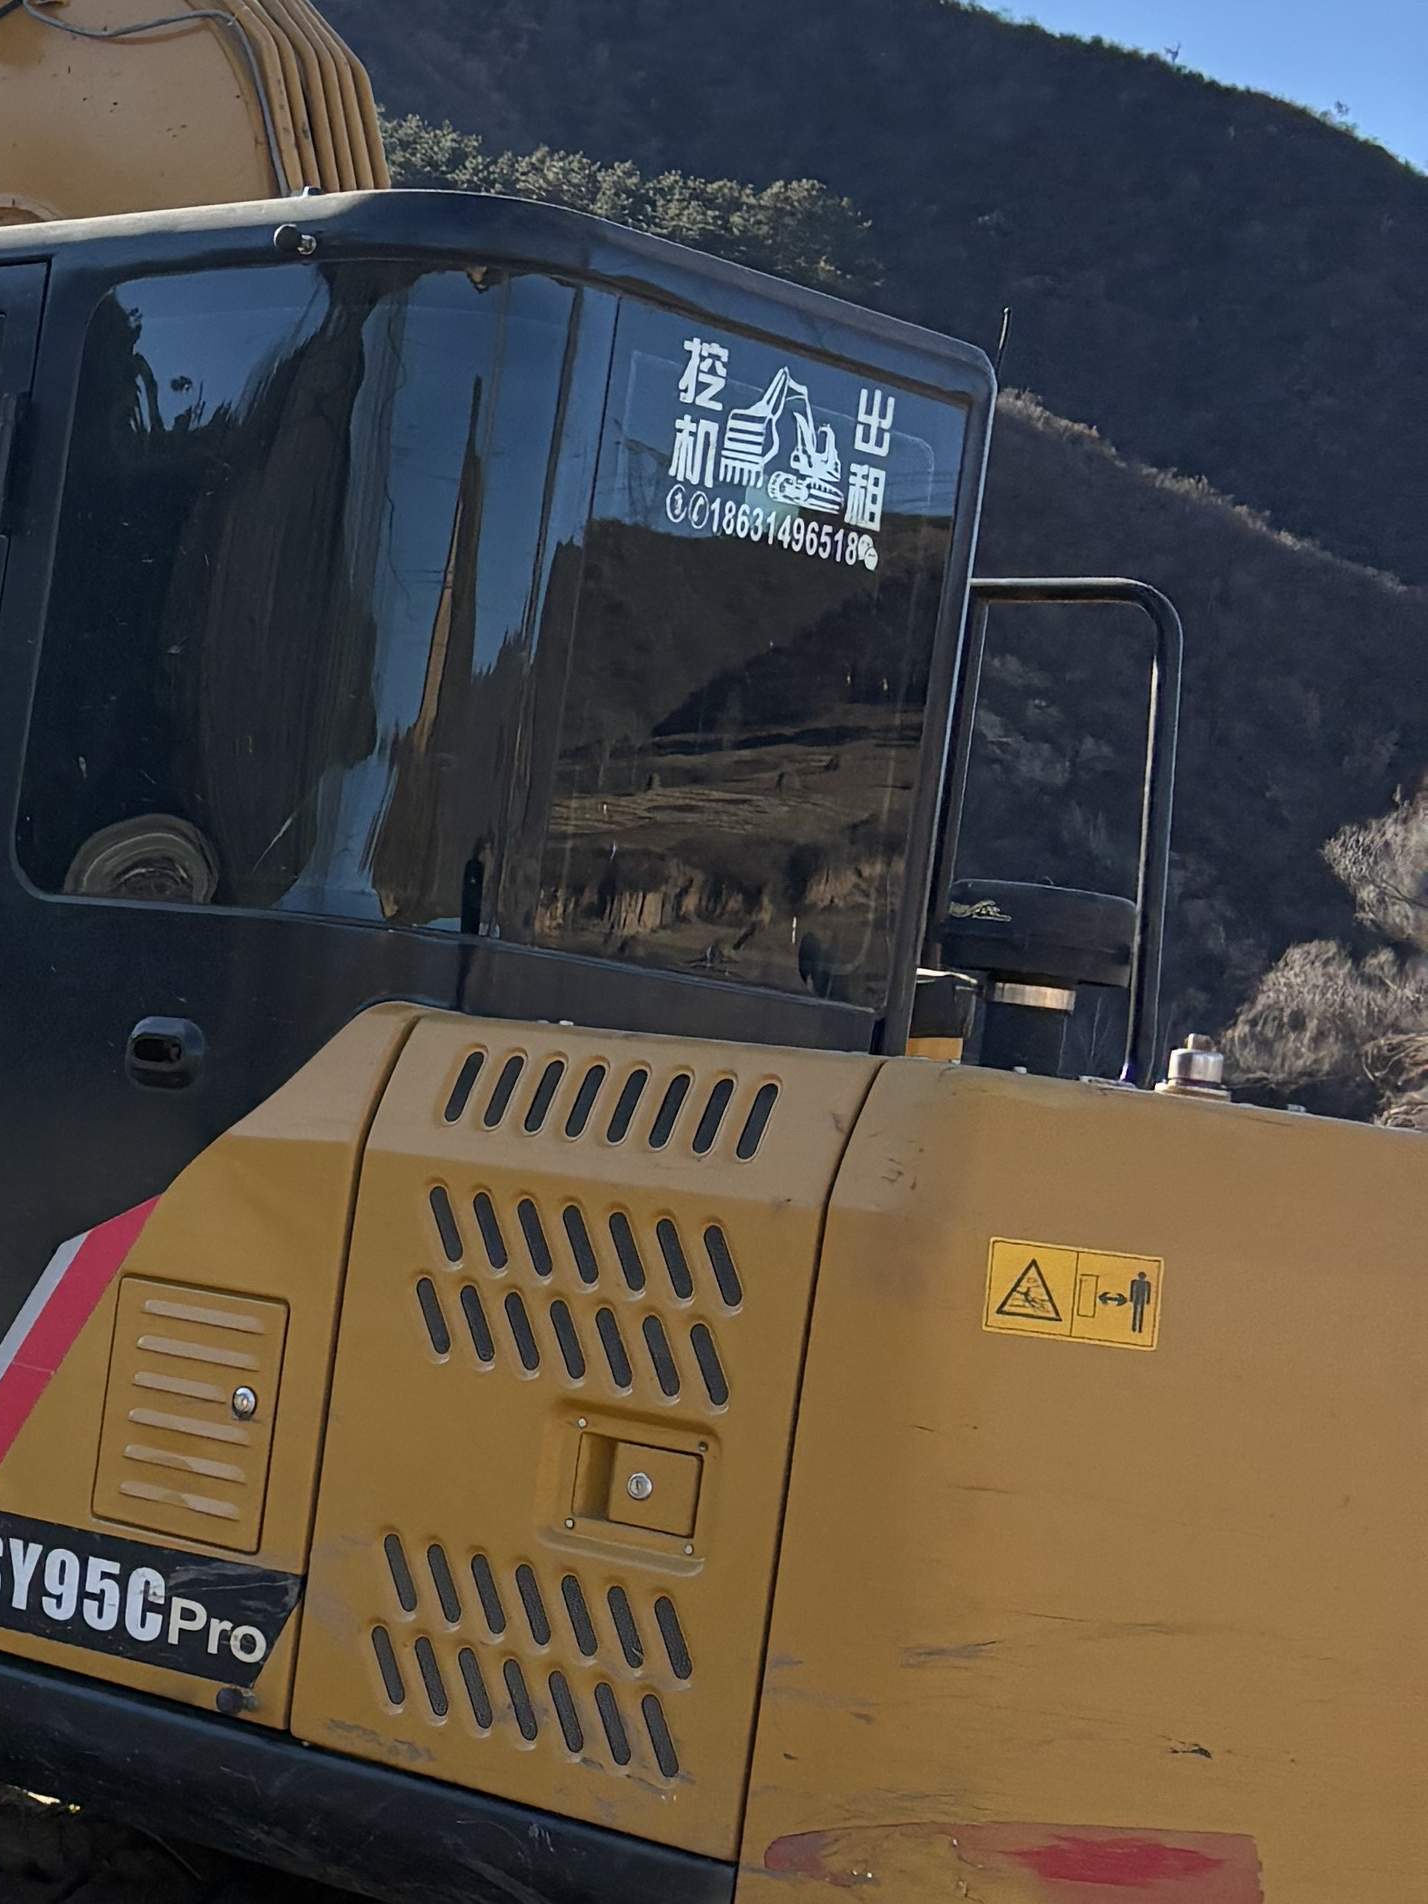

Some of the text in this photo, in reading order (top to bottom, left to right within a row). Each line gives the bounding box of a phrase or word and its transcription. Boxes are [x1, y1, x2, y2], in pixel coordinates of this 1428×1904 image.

[668, 336, 730, 489] 挖机
[843, 387, 896, 533] 出租
[710, 496, 858, 566] 18631496518
